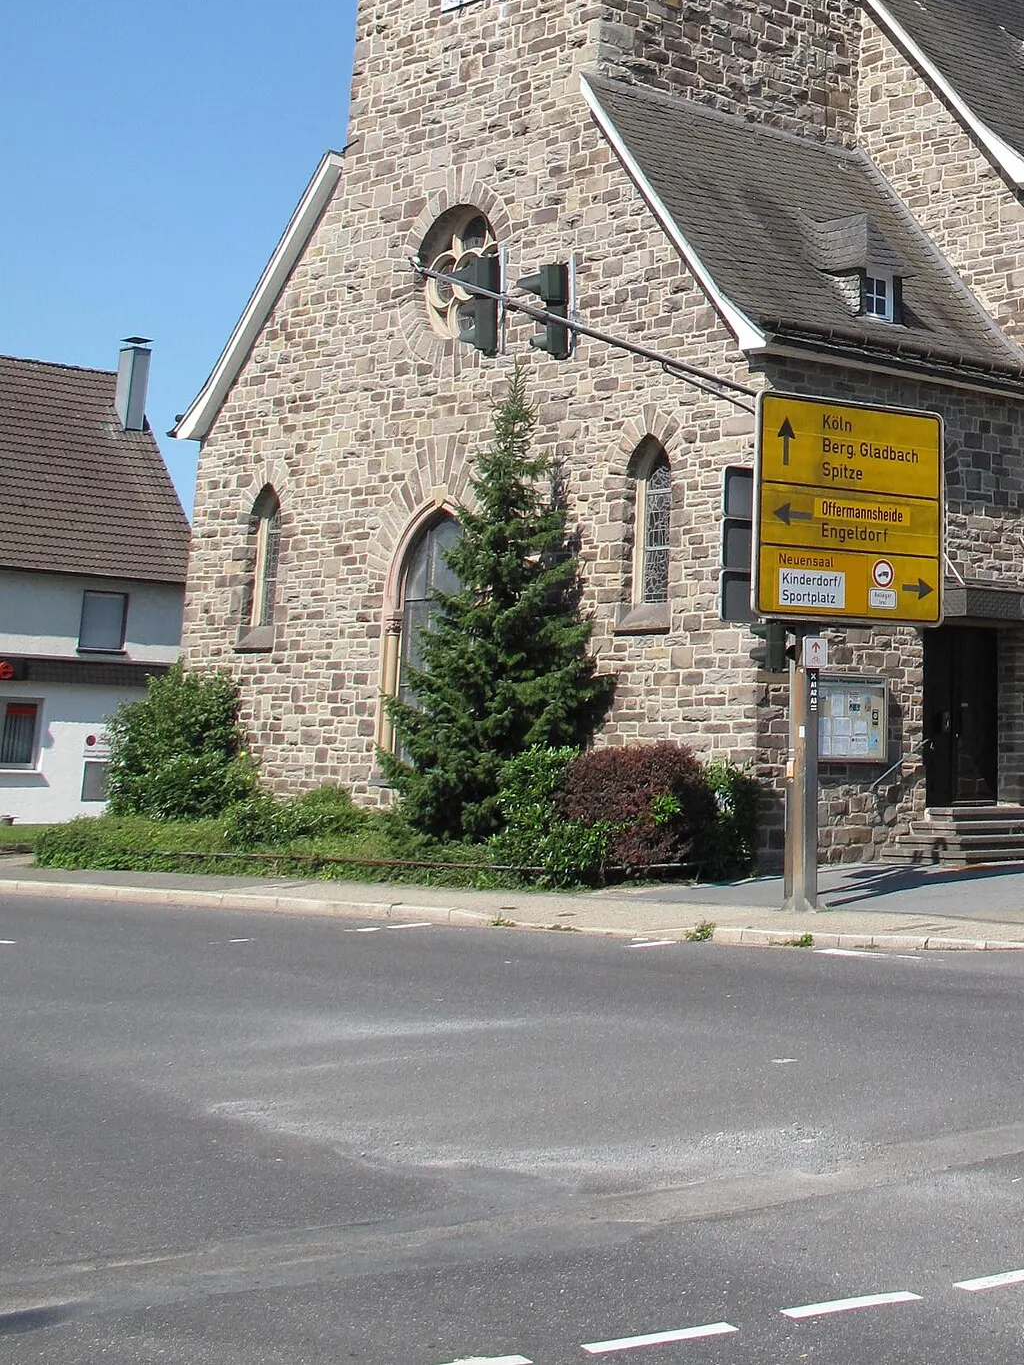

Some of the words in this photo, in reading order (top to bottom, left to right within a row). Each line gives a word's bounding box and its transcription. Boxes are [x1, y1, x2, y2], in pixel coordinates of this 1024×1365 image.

[822, 414, 852, 432] Köln
[822, 438, 856, 459] Berg.
[860, 442, 919, 463] Gladbach
[822, 462, 863, 481] Spitze
[822, 501, 903, 522] Offermannsheide
[821, 523, 889, 543] Engeldorf
[778, 553, 834, 568] Neuensaal
[782, 572, 842, 588] Kinderdorf/
[782, 589, 836, 605] Sportplatz
